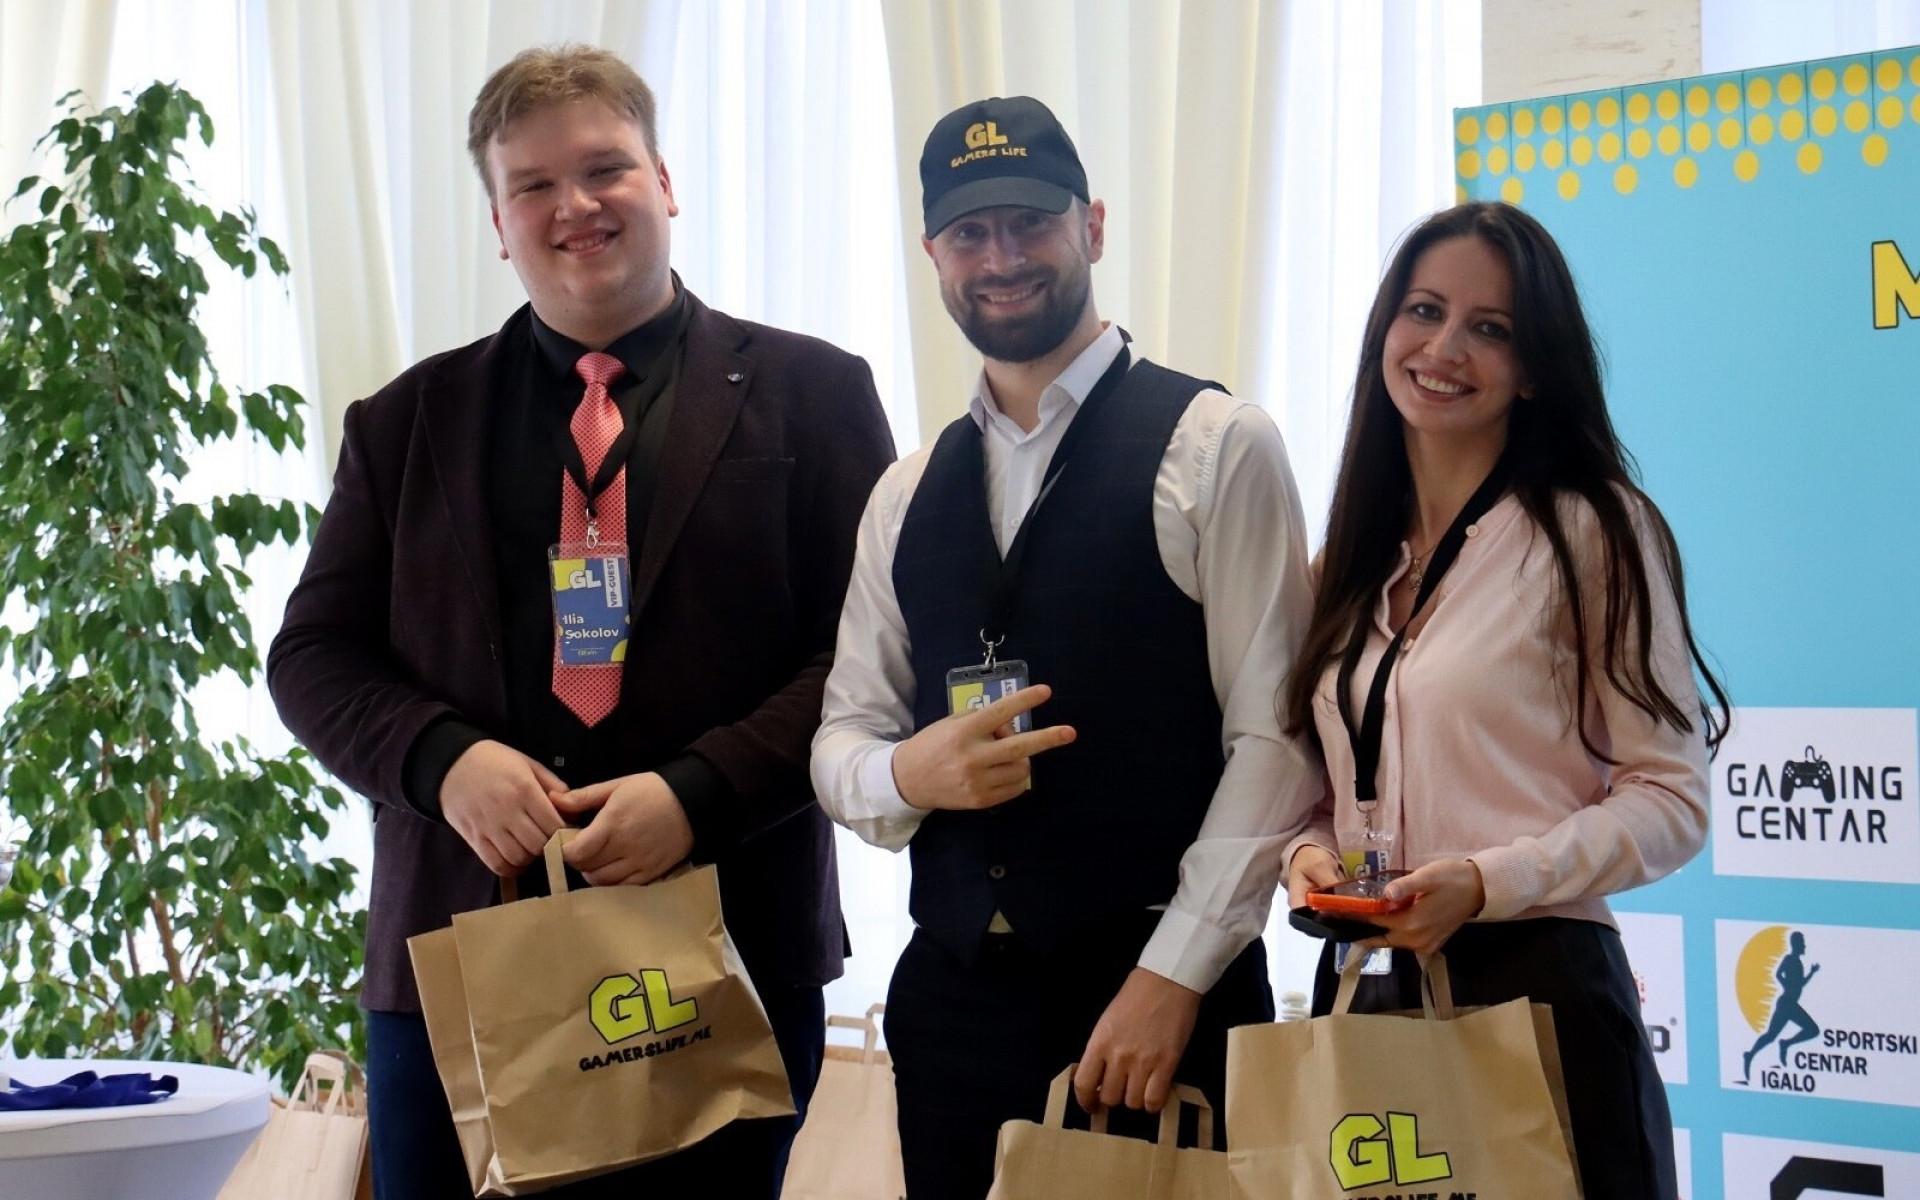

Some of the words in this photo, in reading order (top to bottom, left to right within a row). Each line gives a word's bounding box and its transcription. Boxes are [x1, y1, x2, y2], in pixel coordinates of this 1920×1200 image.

[965, 121, 1008, 150] GL
[951, 149, 997, 168] GAMERS
[1001, 147, 1028, 157] LIFE
[569, 569, 602, 589] GL
[563, 613, 584, 625] Ilia
[565, 627, 619, 639] Sokolov
[1737, 805, 1887, 843] CENTAR
[589, 968, 698, 1045] GL
[1823, 1029, 1918, 1055] SPORTSKI
[1794, 1051, 1868, 1075] CENTAR
[1762, 1070, 1816, 1093] IGALO
[1329, 1111, 1452, 1191] GL
